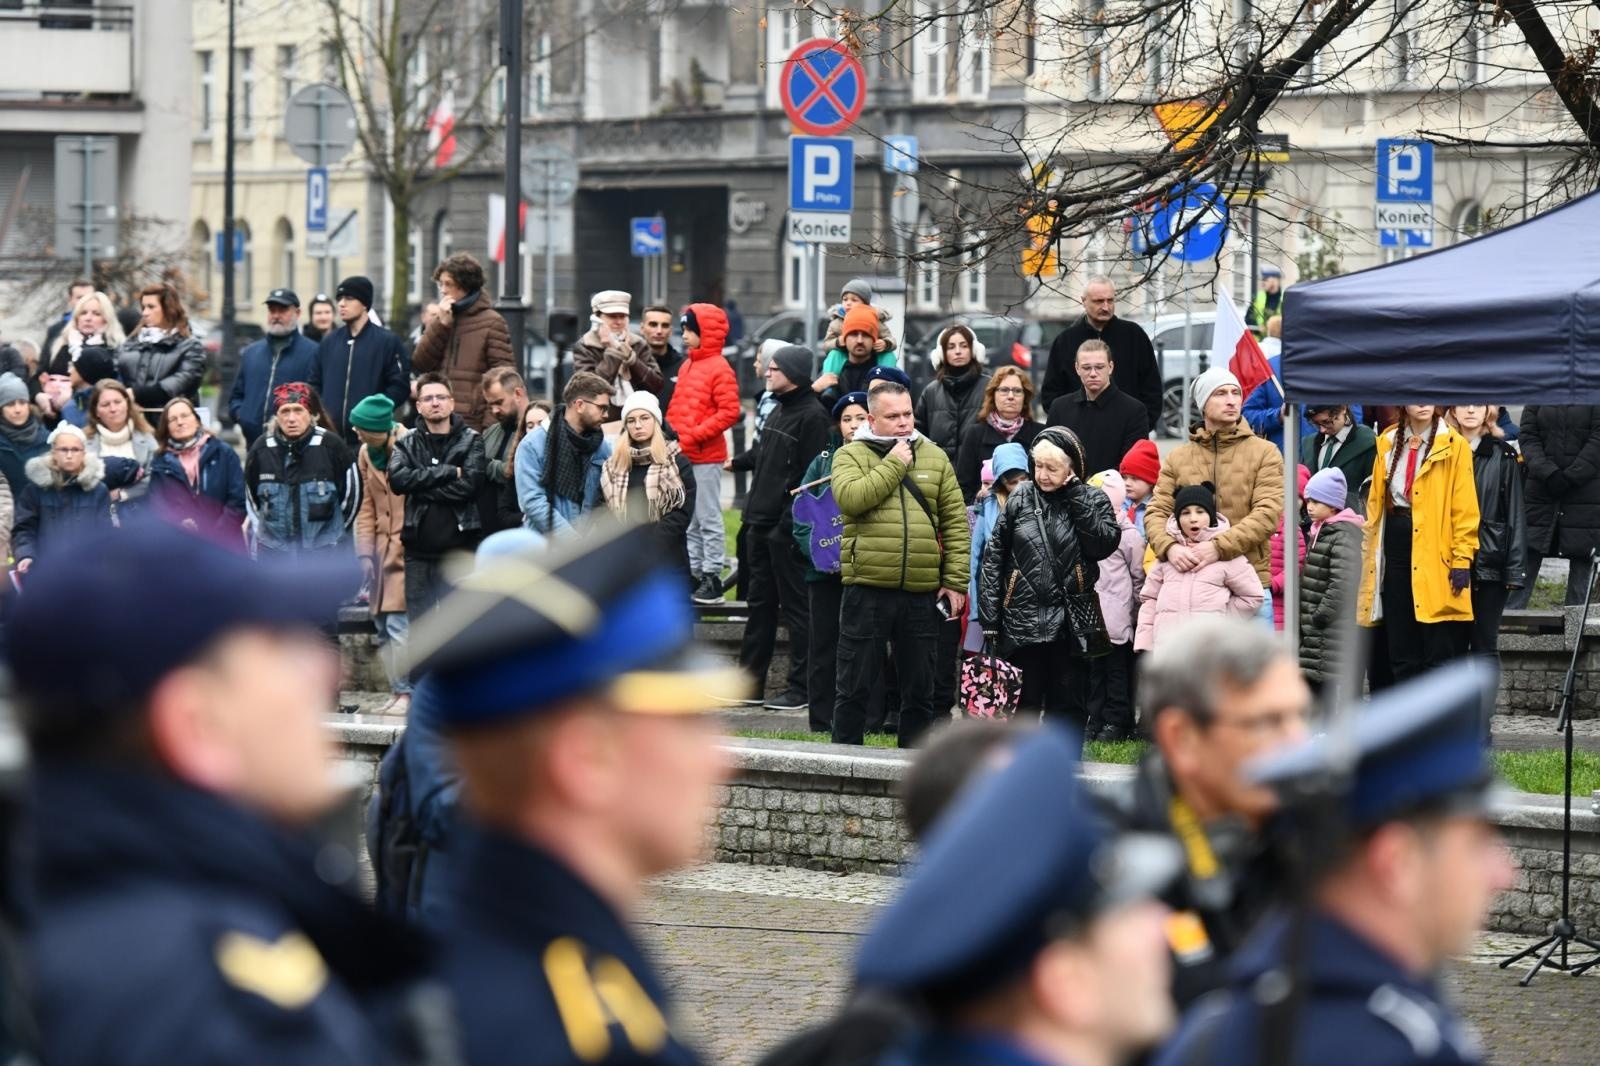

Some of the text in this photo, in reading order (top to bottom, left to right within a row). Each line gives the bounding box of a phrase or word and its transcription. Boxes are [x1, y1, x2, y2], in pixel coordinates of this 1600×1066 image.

[804, 145, 840, 202] P
[1389, 144, 1421, 194] P
[310, 173, 324, 222] P
[1379, 209, 1429, 224] Koniec
[792, 219, 847, 236] Koniec
